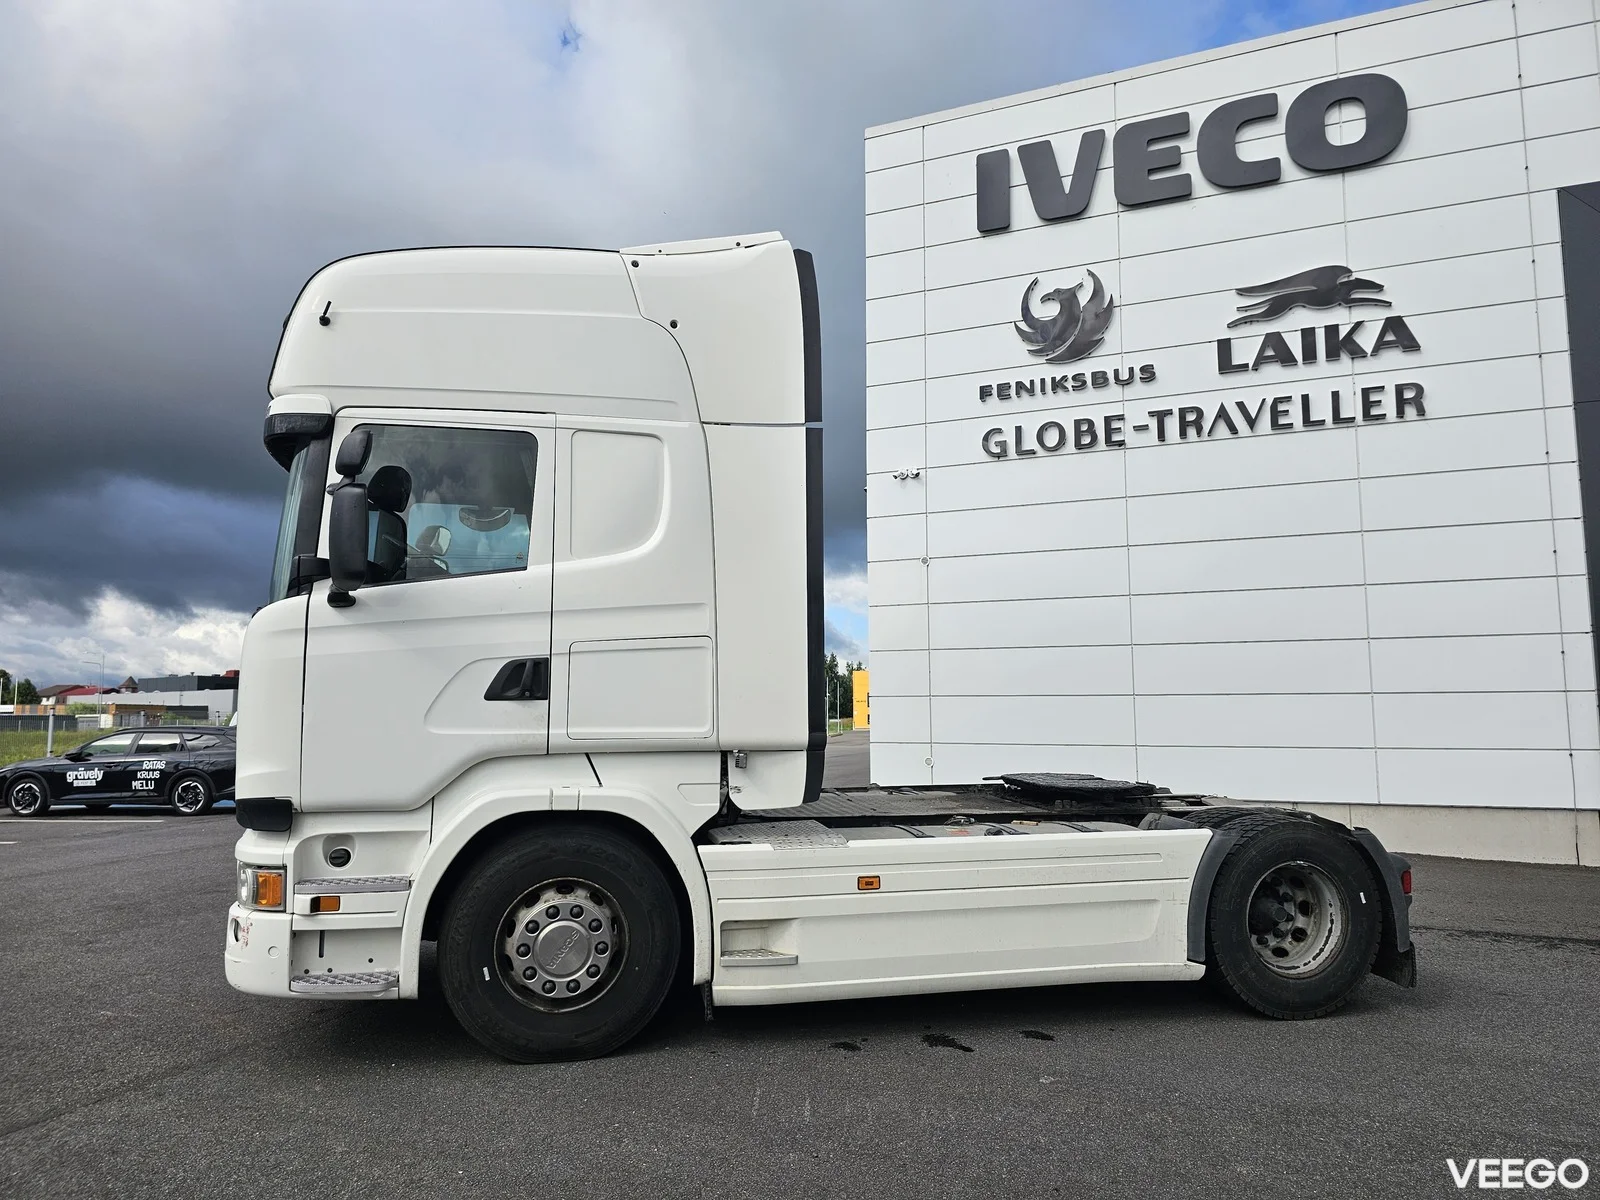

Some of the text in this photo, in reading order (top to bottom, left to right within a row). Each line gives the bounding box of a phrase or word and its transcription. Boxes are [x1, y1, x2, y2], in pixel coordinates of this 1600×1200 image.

[976, 73, 1408, 234] IVECO
[1216, 314, 1422, 375] LAIKA
[979, 363, 1157, 402] FENIKSBUS
[981, 381, 1427, 460] GLOBE-TRAVELLER
[66, 768, 104, 783] grävely
[137, 771, 160, 779] KRUUS
[143, 760, 166, 770] RATAS
[131, 780, 155, 790] MELU
